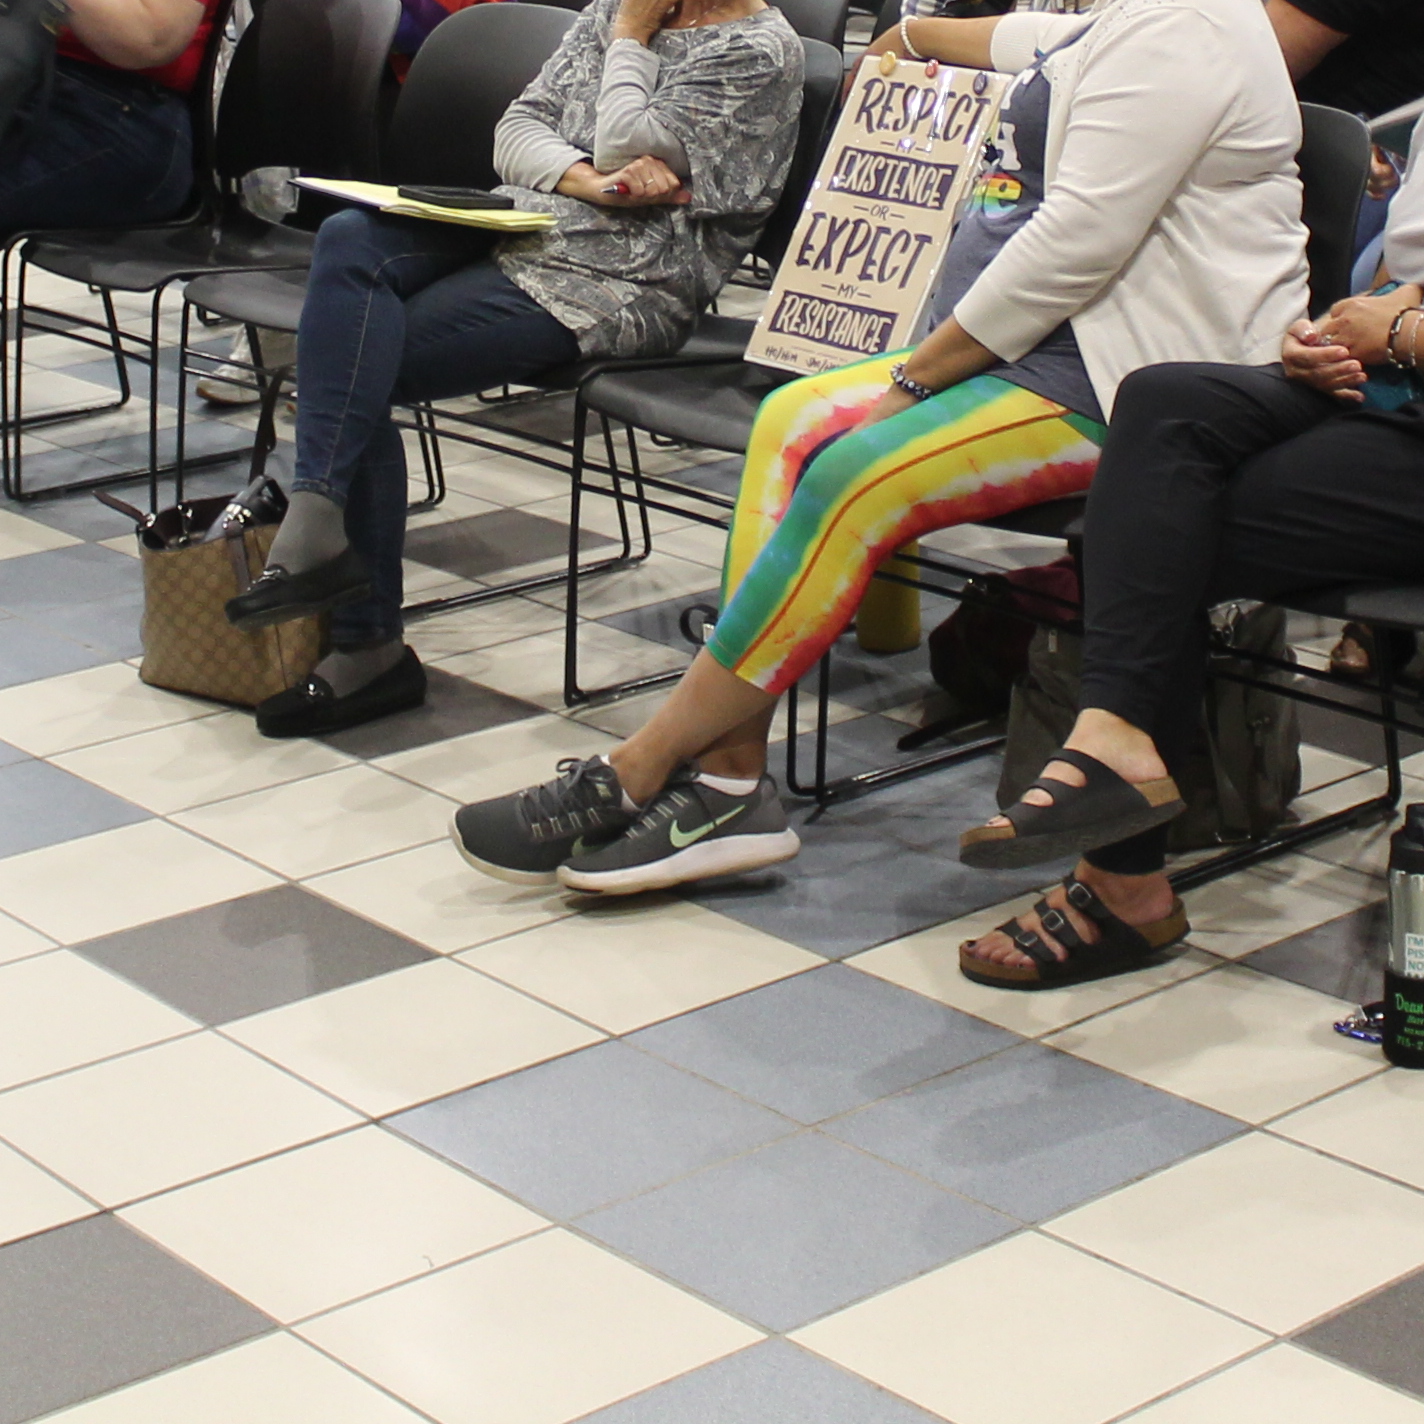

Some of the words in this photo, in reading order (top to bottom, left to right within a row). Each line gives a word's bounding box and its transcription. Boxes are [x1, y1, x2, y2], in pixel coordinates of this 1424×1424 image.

[855, 78, 991, 145] RESPECT
[836, 150, 953, 208] EXISTENCE
[870, 204, 890, 220] OR
[795, 212, 933, 289] EXPECT
[837, 284, 858, 299] MY
[775, 294, 893, 354] RESISTANCE
